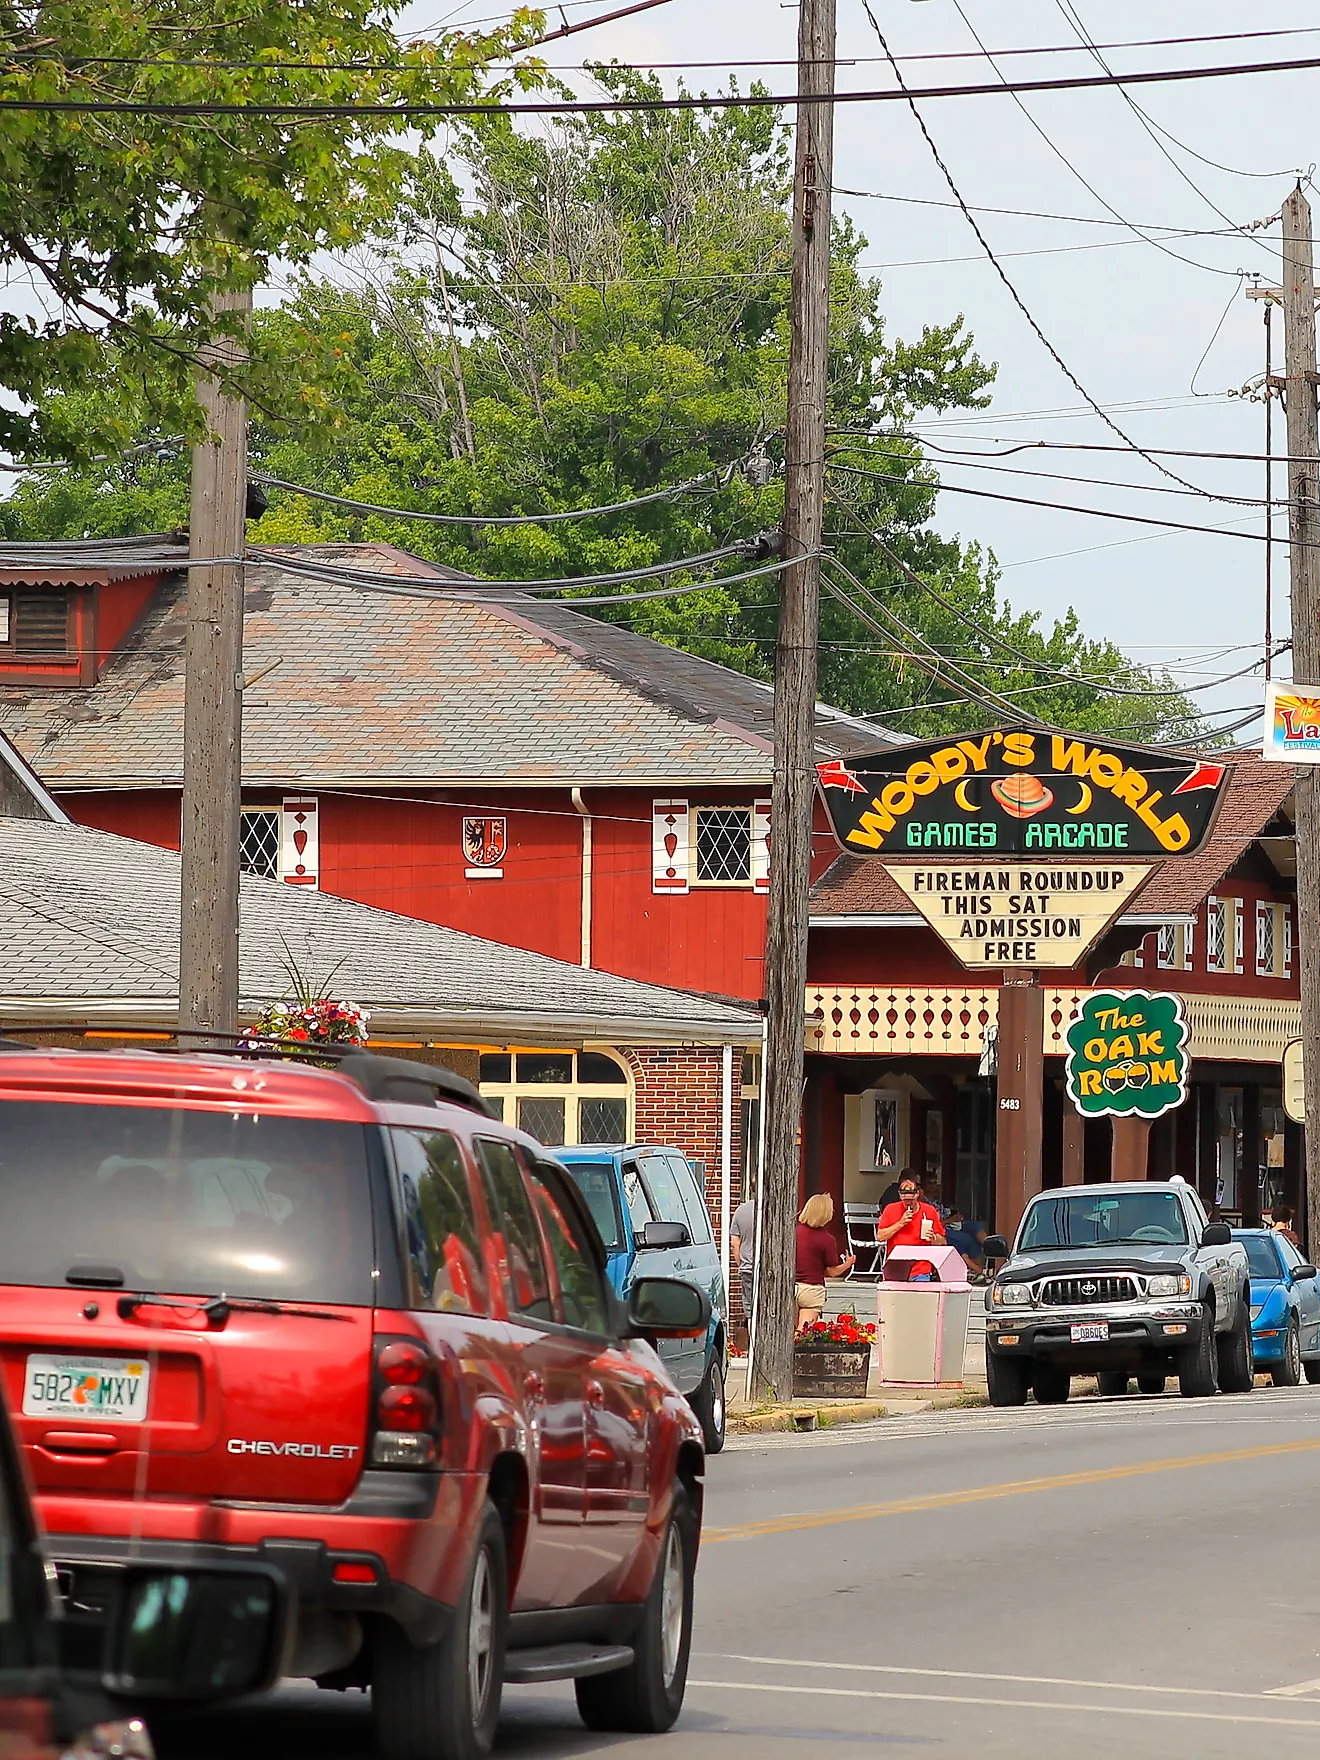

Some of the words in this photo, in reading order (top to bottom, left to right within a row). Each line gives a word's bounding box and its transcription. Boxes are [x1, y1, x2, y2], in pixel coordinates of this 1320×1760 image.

[845, 732, 1036, 850] WOODY'S
[1051, 734, 1192, 852] WORLD
[907, 822, 997, 848] GAMES
[1025, 822, 1129, 848] ARCADE
[914, 872, 1010, 891] FIREMAN
[1019, 871, 1124, 891] ROUNDUP
[941, 896, 992, 914] THIS
[1008, 896, 1048, 914] SAT
[960, 919, 1081, 938] ADMISSION
[984, 942, 1036, 961] FREE
[1095, 1006, 1146, 1032] The
[1083, 1030, 1165, 1063] OAK
[1078, 1059, 1179, 1096] ROOM
[1000, 1098, 1020, 1110] 5483
[32, 1373, 72, 1402] 582
[99, 1377, 139, 1405] MXV
[227, 1438, 359, 1460] CHEVROLET
